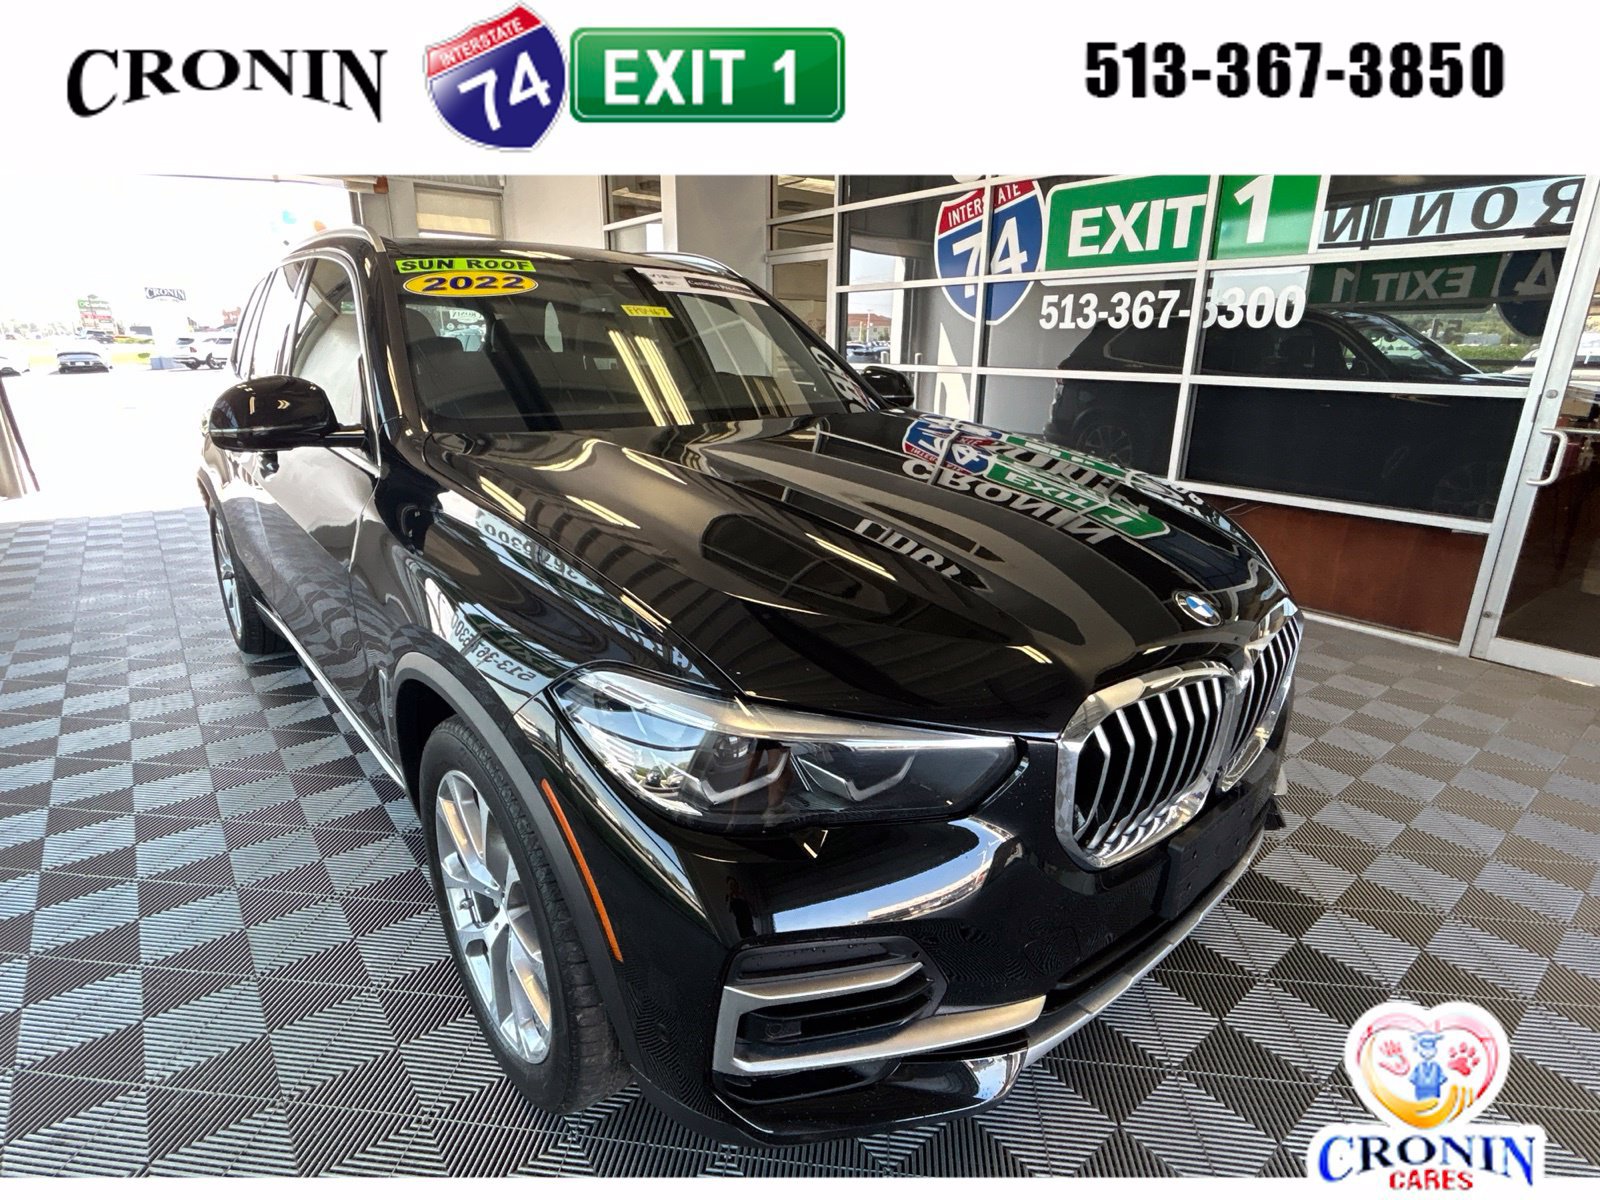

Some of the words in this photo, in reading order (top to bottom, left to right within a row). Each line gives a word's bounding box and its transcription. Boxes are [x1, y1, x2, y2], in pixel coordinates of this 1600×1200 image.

[1068, 193, 1208, 257] EXIT
[1234, 175, 1274, 244] 1
[400, 259, 454, 271] SUN
[466, 259, 530, 270] ROOF
[952, 216, 1028, 299] 74
[422, 275, 526, 292] 2022
[145, 286, 186, 300] CRONIN
